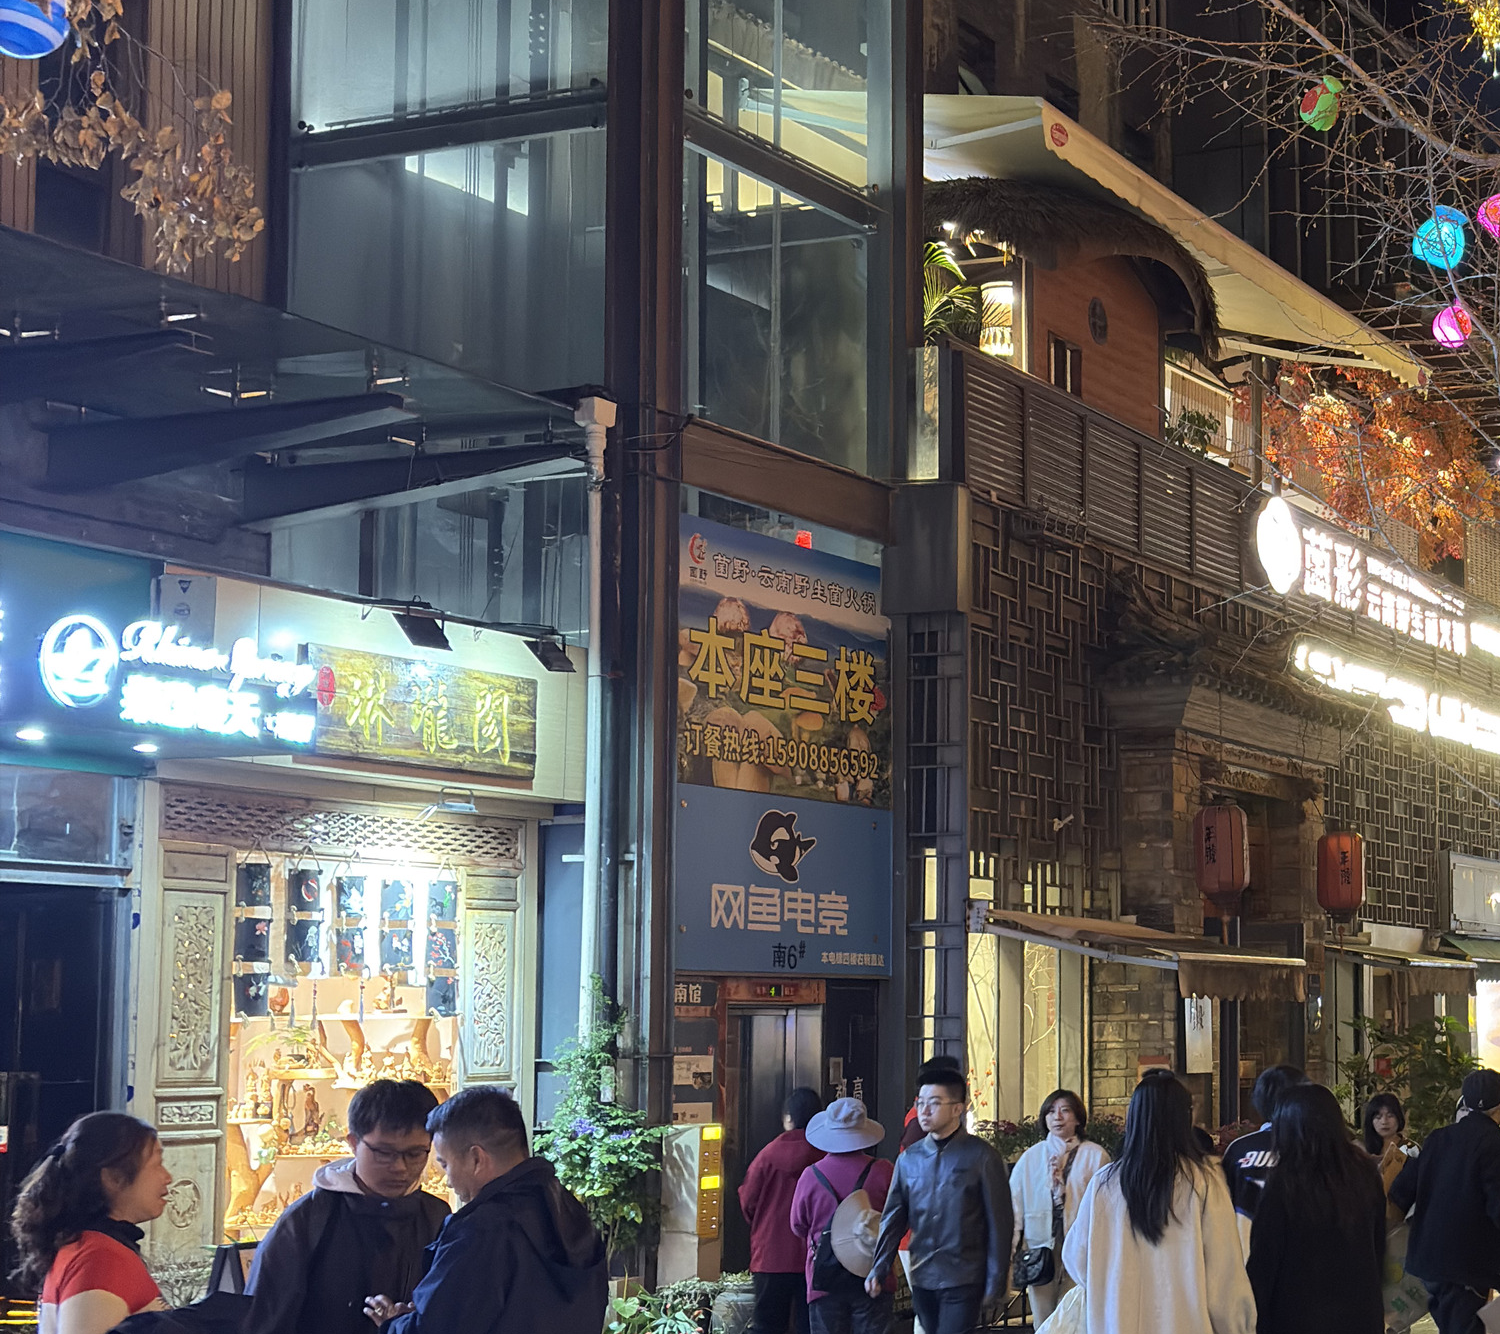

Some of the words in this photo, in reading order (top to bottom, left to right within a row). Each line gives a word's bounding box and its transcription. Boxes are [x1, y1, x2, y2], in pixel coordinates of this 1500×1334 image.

[688, 616, 876, 725] 本座三楼
[710, 882, 850, 936] 网鱼电竞
